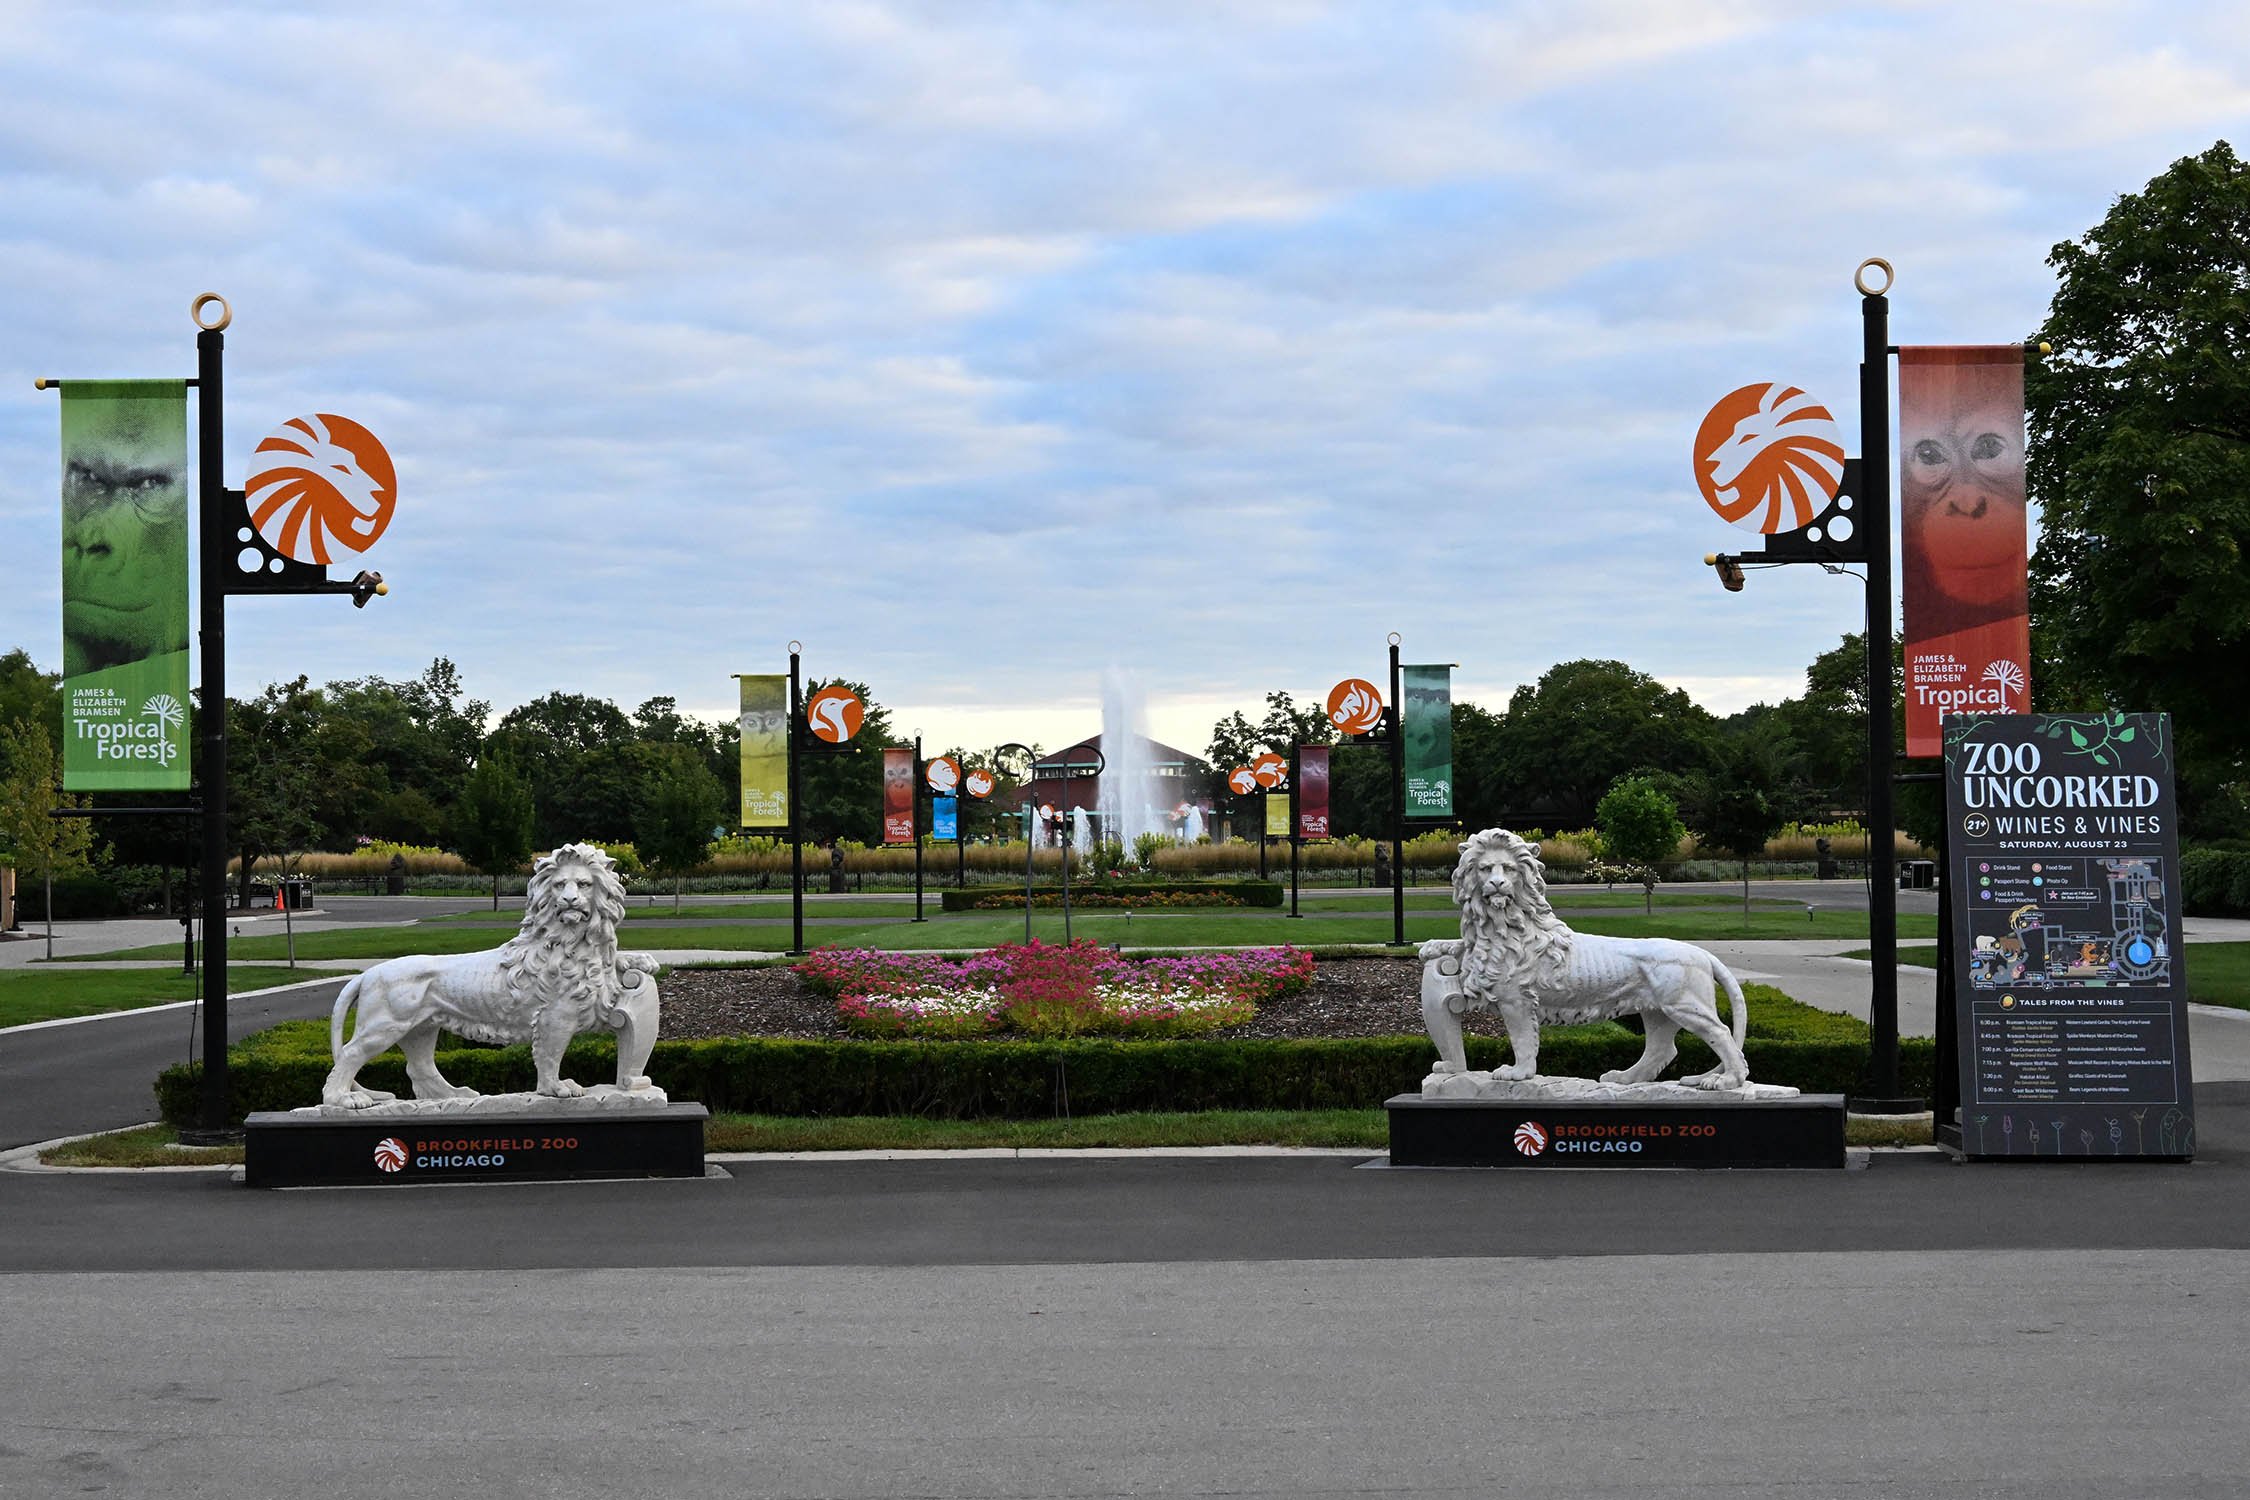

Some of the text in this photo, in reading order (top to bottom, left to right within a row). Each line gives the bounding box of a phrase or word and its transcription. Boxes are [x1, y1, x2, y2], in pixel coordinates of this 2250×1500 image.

[1913, 654, 1955, 663] JAMES &
[1914, 664, 1967, 673] ELIZABETH
[1914, 674, 1961, 682] BRAMSEN
[73, 689, 115, 697] JAMES &
[1914, 684, 2006, 710] Tropical
[73, 698, 126, 706] ELIZABETH
[73, 708, 120, 716] BRAMSEN
[73, 718, 165, 743] Tropical
[97, 740, 177, 763] Forests
[1963, 742, 2041, 775] ZOO
[1409, 789, 1444, 798] Tropical
[1964, 775, 2159, 808] UNCORKED
[745, 800, 779, 810] Tropical
[1418, 797, 1448, 805] Forests
[753, 808, 783, 816] Forests
[1967, 819, 1987, 830] 21+
[1995, 815, 2161, 834] WINES & VINES
[2064, 840, 2111, 848] AUGUST
[2114, 840, 2127, 848] 23
[1555, 1125, 1717, 1137] BROOKFIELD ZOO
[416, 1138, 579, 1152] BROOKFIELD ZOO
[1555, 1141, 1643, 1153] CHICAGO
[416, 1154, 505, 1168] CHICAGO
